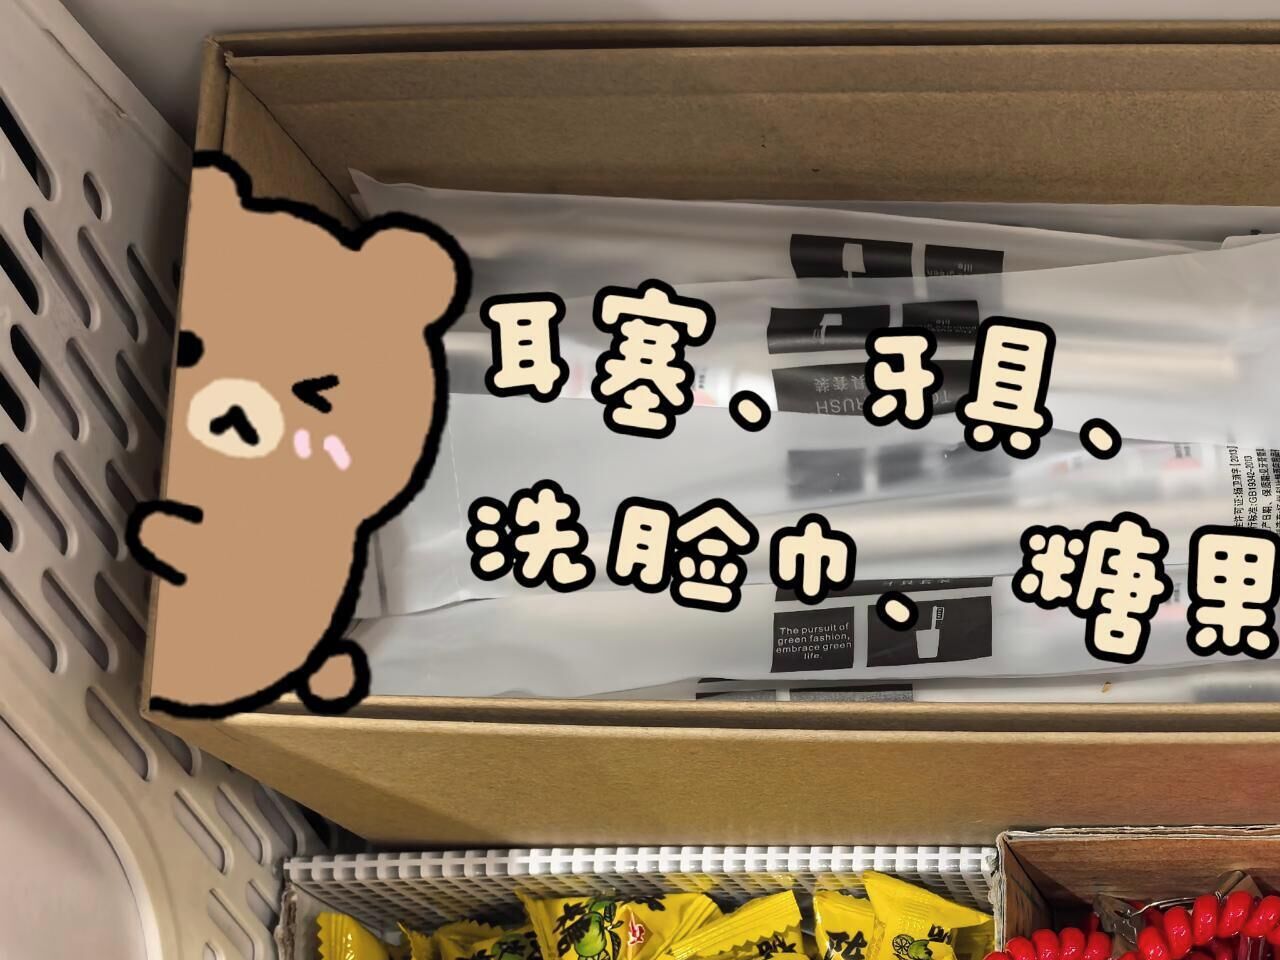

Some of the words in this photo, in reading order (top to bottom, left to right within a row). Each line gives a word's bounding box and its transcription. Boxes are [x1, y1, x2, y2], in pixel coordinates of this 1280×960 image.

[780, 627, 799, 636] The
[801, 623, 837, 635] pursuit
[839, 622, 850, 631] of
[776, 644, 820, 654] embrace
[822, 642, 852, 652] green
[777, 637, 807, 647] green
